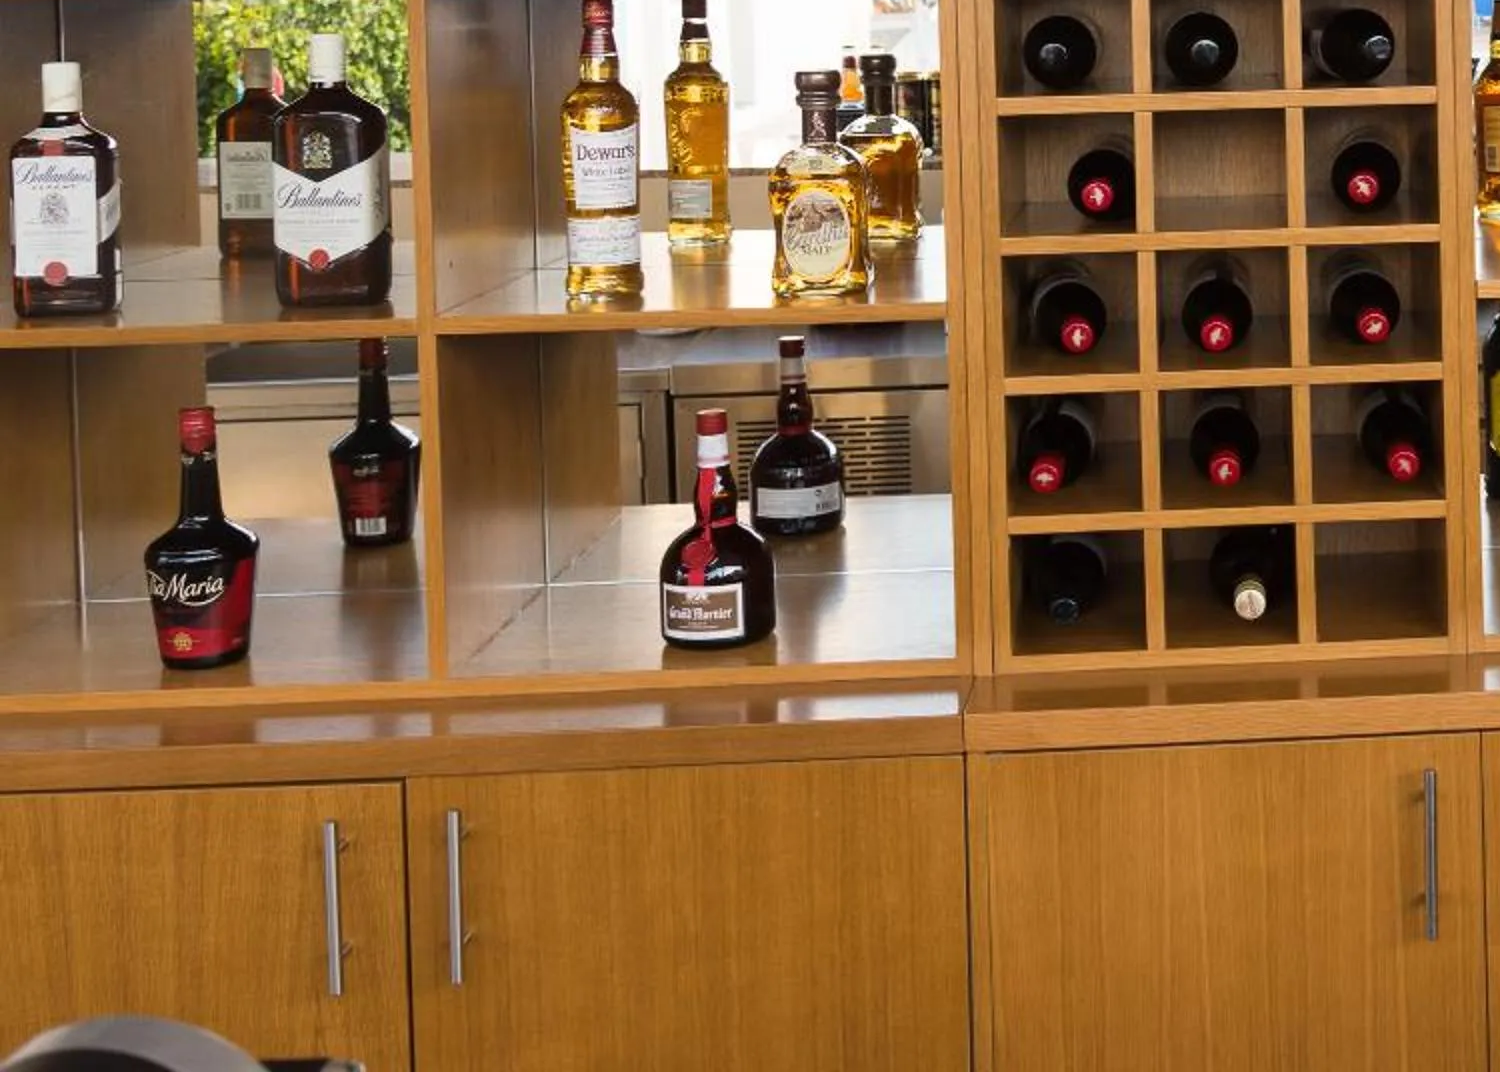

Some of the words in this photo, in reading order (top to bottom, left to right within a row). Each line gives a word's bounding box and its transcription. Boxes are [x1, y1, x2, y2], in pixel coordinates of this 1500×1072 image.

[576, 143, 635, 163] Dewar's
[277, 182, 363, 210] Ballantine's
[163, 572, 224, 604] Maria
